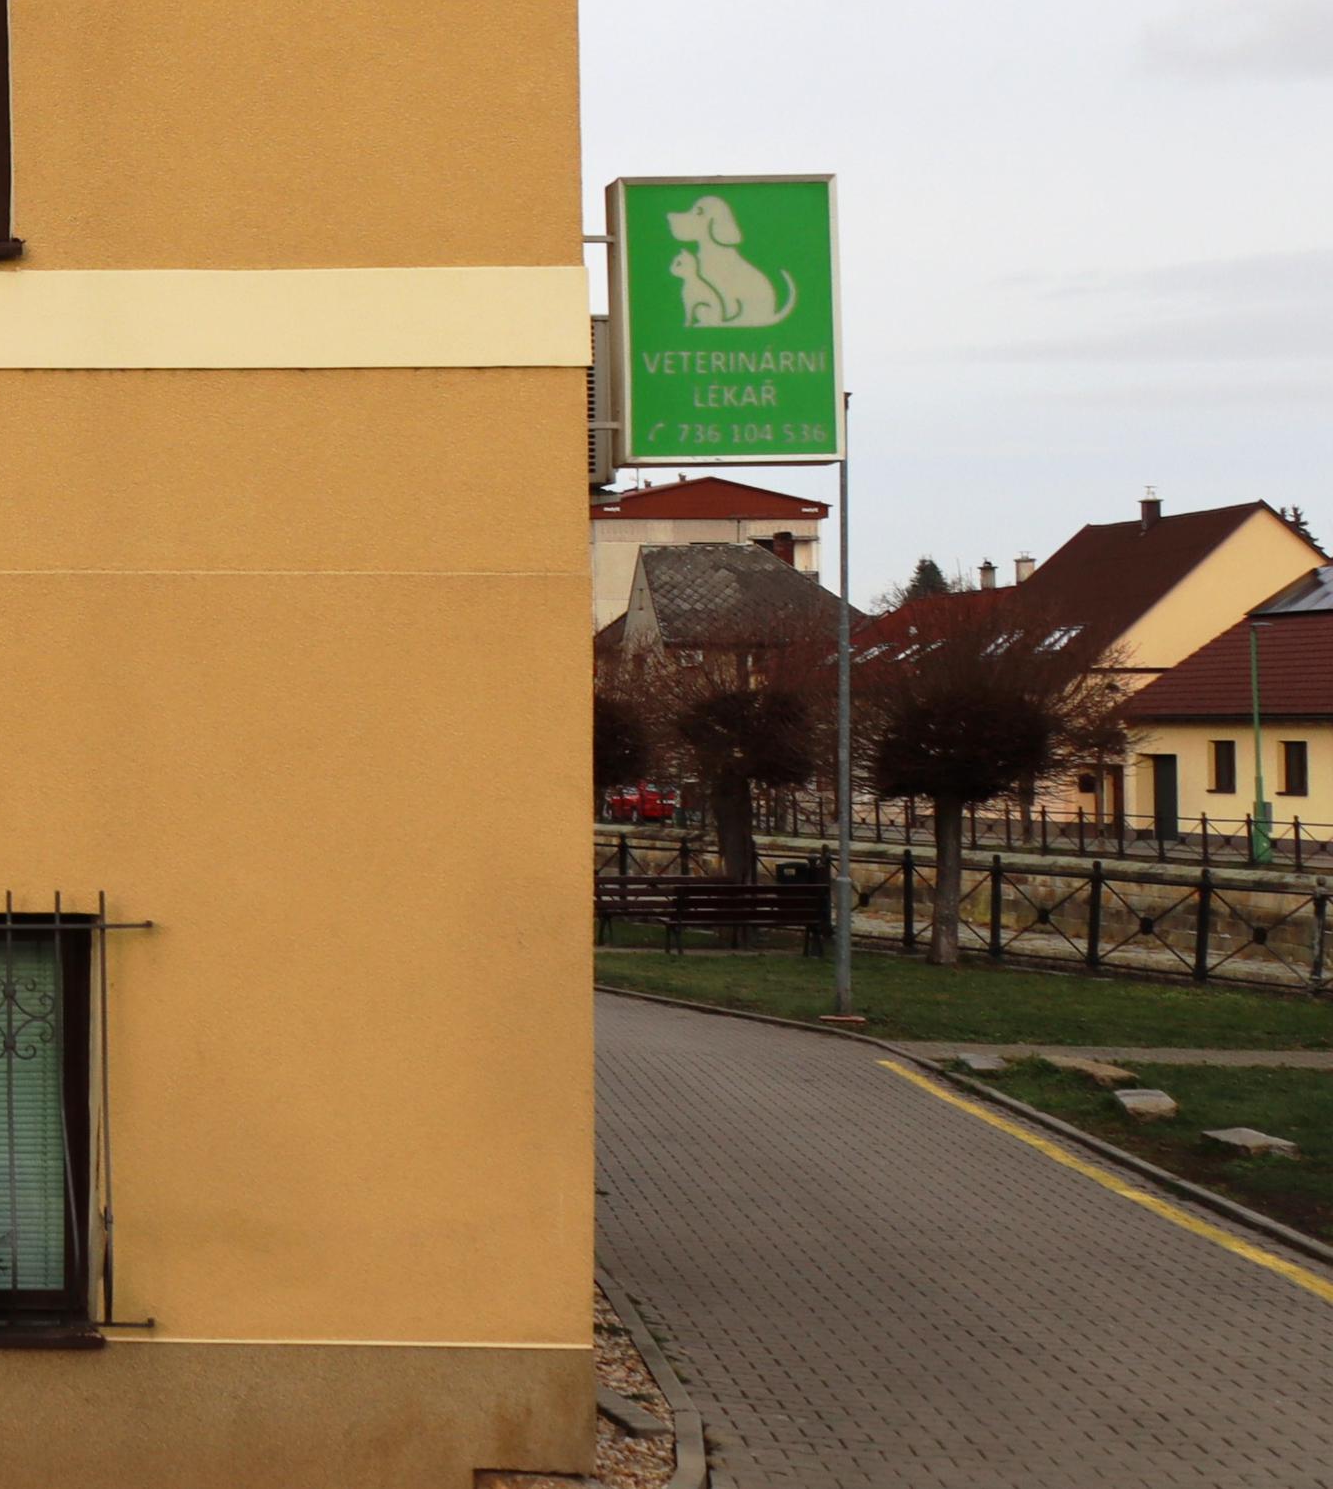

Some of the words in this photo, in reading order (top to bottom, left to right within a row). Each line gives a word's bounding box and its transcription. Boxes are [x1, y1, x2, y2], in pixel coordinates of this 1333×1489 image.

[641, 345, 828, 374] VETERINÁRNÍ
[693, 380, 778, 408] LÉKAŘ
[678, 424, 721, 442] 736
[731, 423, 773, 442] 104
[783, 423, 827, 442] 536
